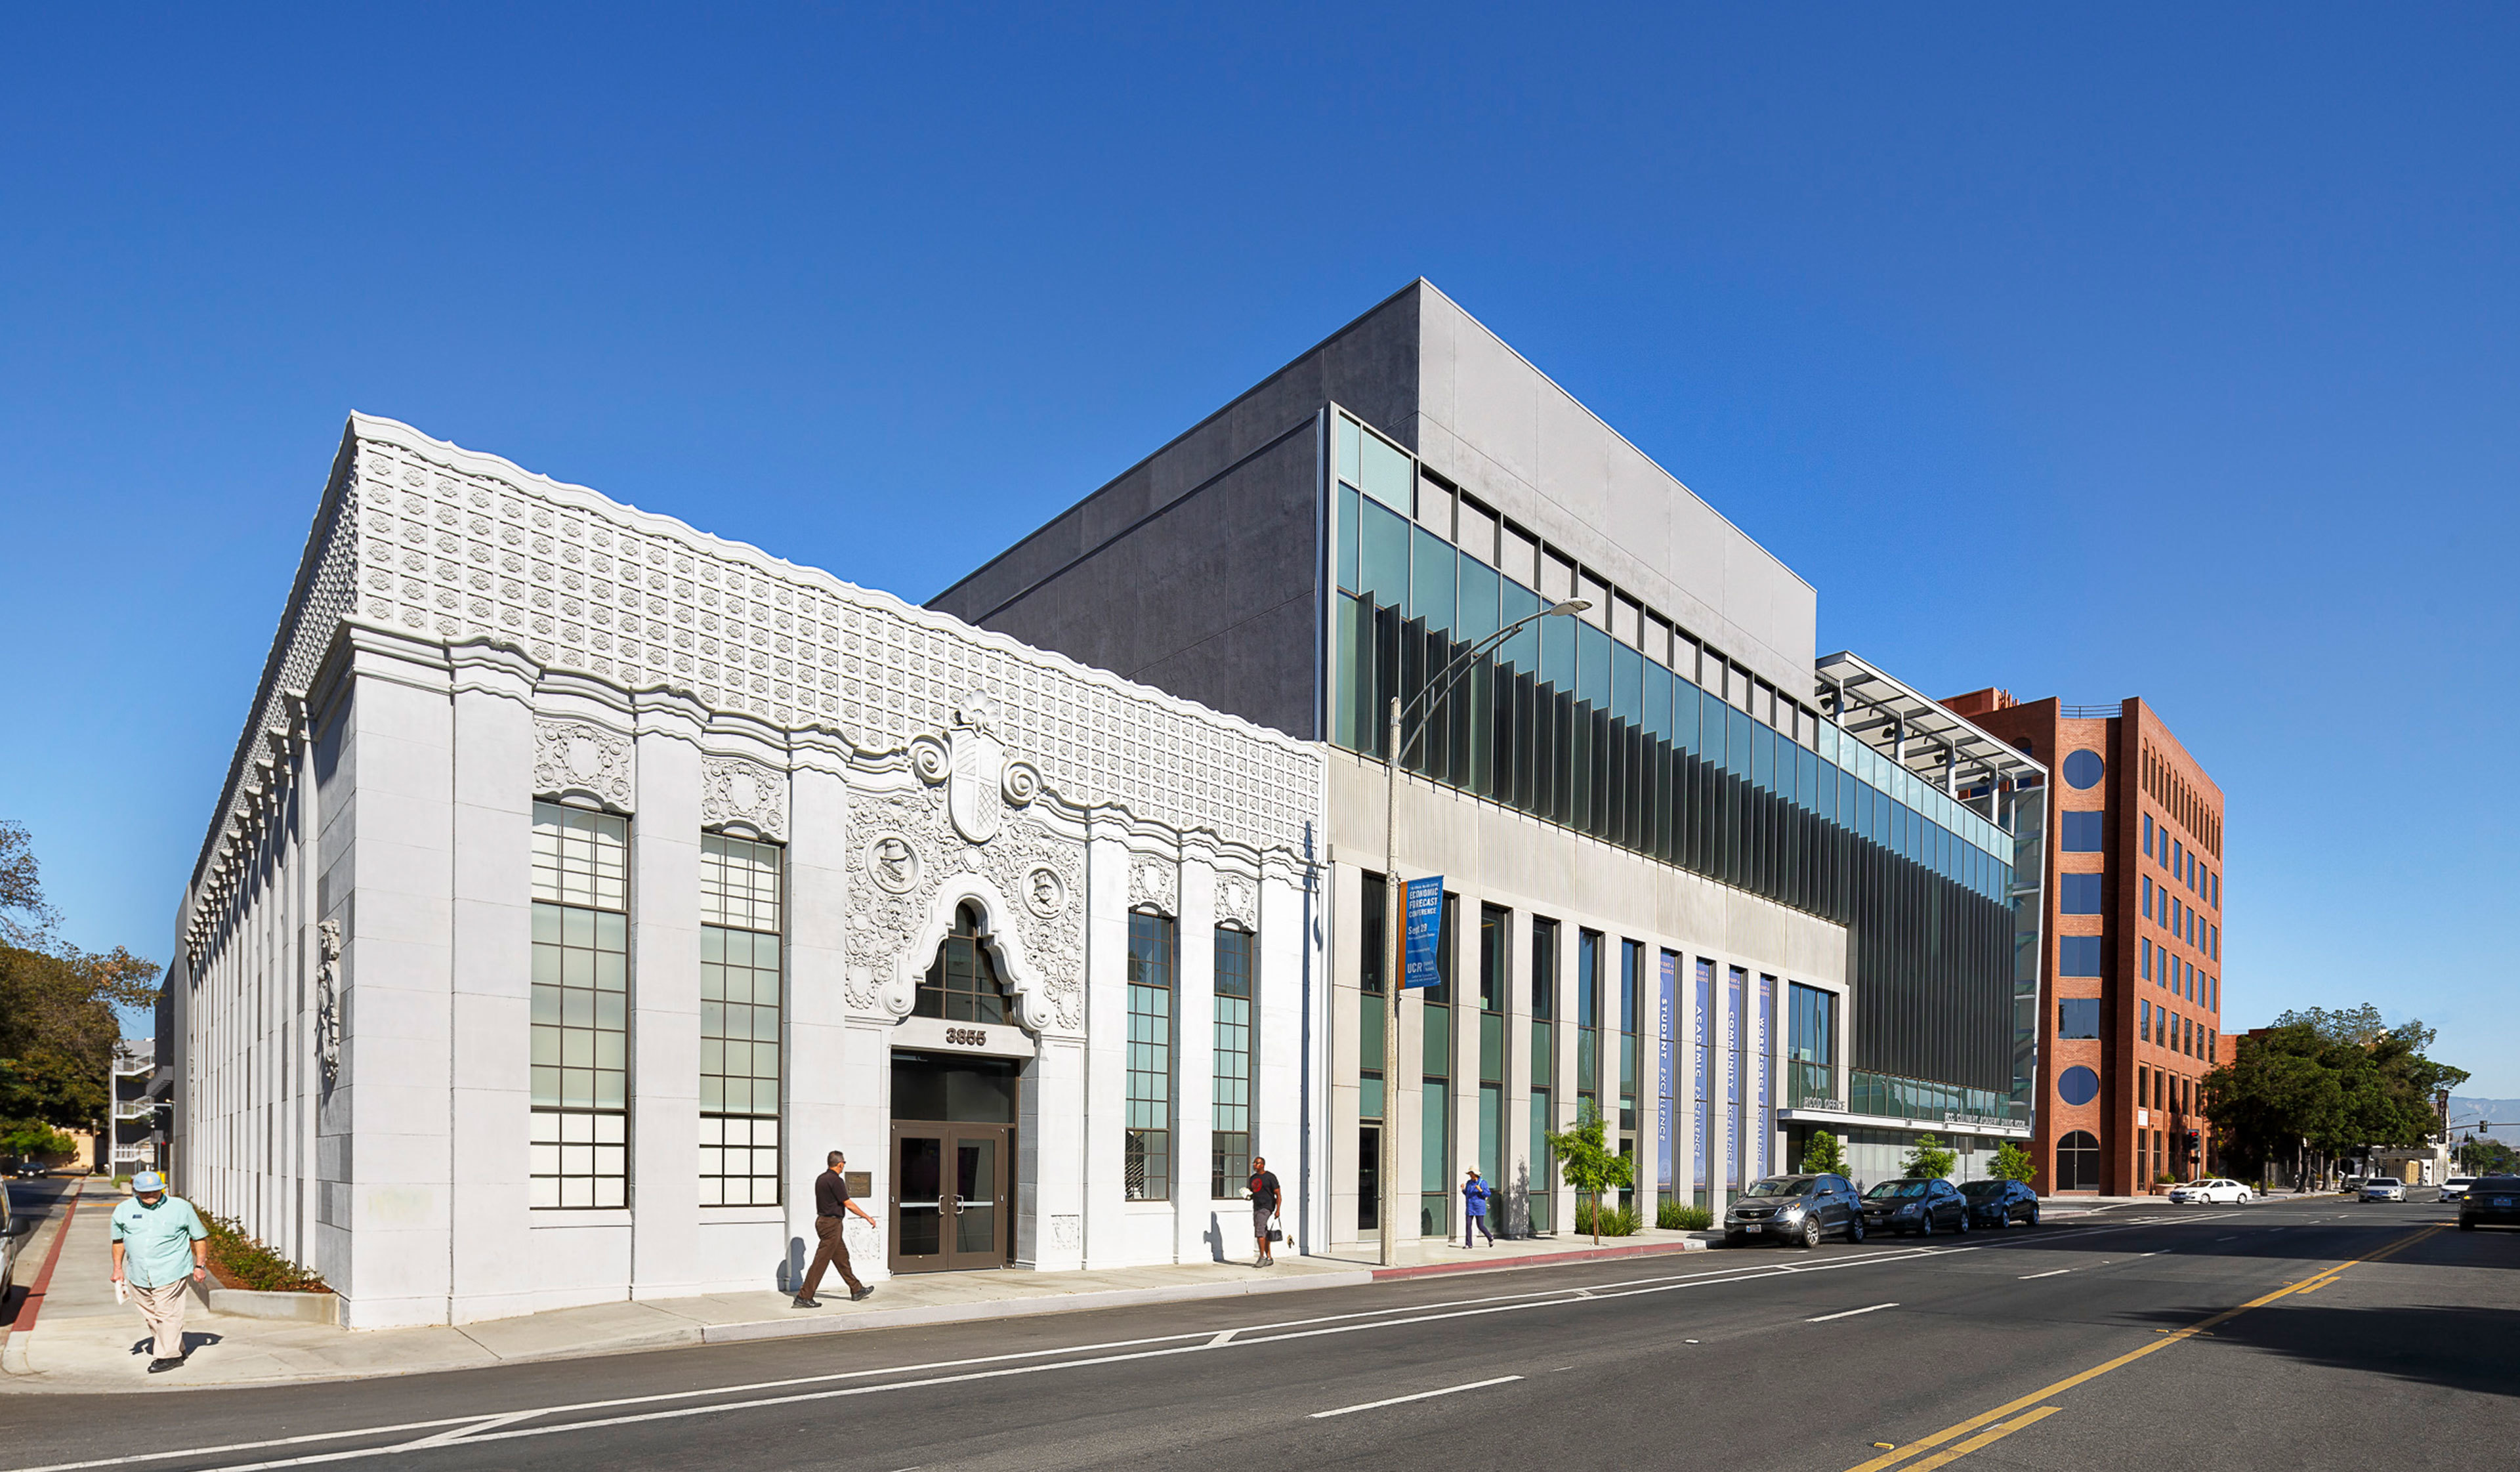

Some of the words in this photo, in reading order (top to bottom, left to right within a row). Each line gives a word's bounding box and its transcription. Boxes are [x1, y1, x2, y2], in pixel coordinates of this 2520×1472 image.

[1409, 897, 1438, 910] FORECAST
[1420, 923, 1427, 933] 29
[1407, 961, 1423, 974] UCR
[946, 1027, 986, 1046] 3855
[1824, 1099, 1845, 1111] OFFICE
